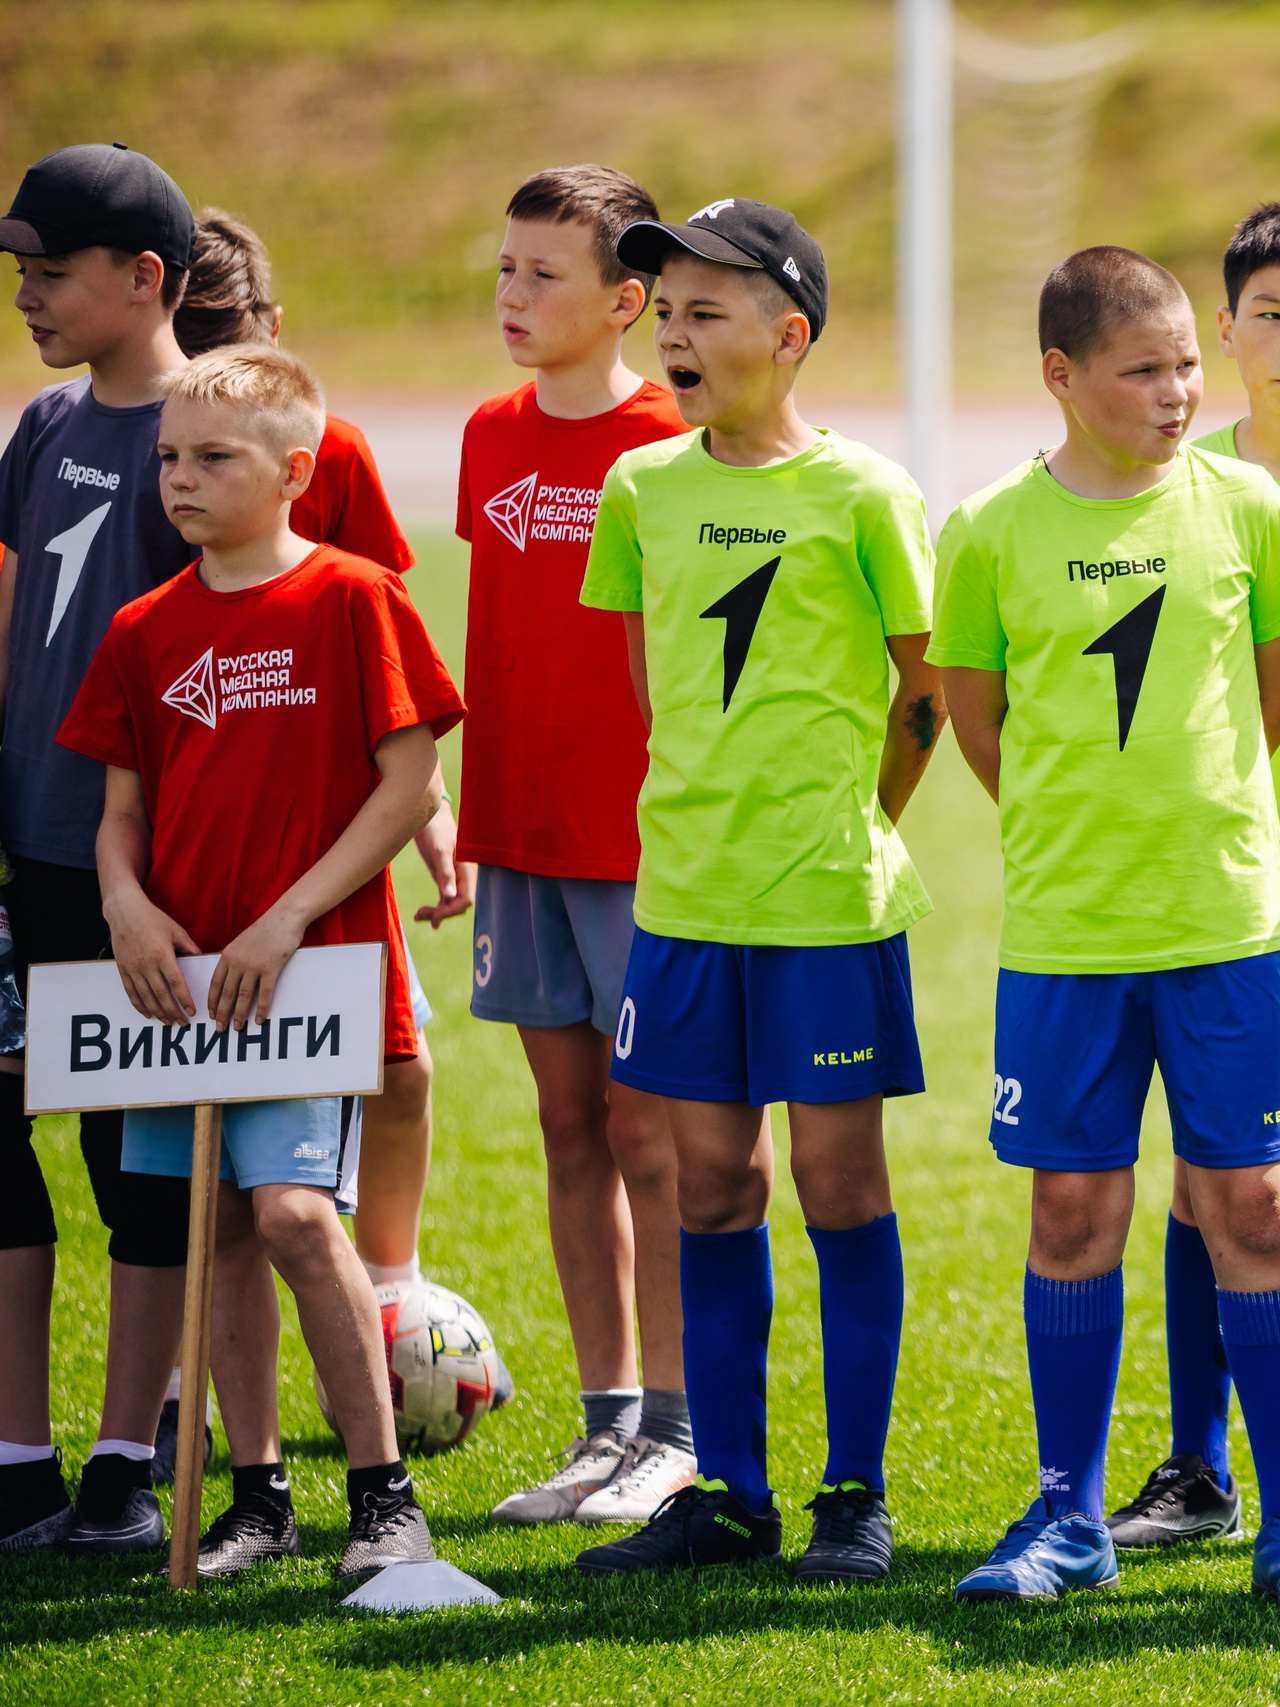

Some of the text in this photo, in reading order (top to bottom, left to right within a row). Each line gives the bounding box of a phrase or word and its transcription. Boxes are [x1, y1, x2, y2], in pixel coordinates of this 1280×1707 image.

[57, 457, 120, 491] Первые
[537, 485, 603, 506] РУССКАЯ
[533, 504, 598, 524] МЕДНАЯ
[698, 523, 787, 551] Первые
[1067, 556, 1166, 585] Первые
[218, 648, 293, 675] РУССКАЯ
[219, 669, 290, 695] МЕДНАЯ
[221, 687, 317, 714] КОМПАНИЯ
[475, 934, 493, 988] 3
[70, 1013, 341, 1073] Викинги
[813, 1047, 874, 1066] KELME
[994, 1073, 1023, 1126] 22
